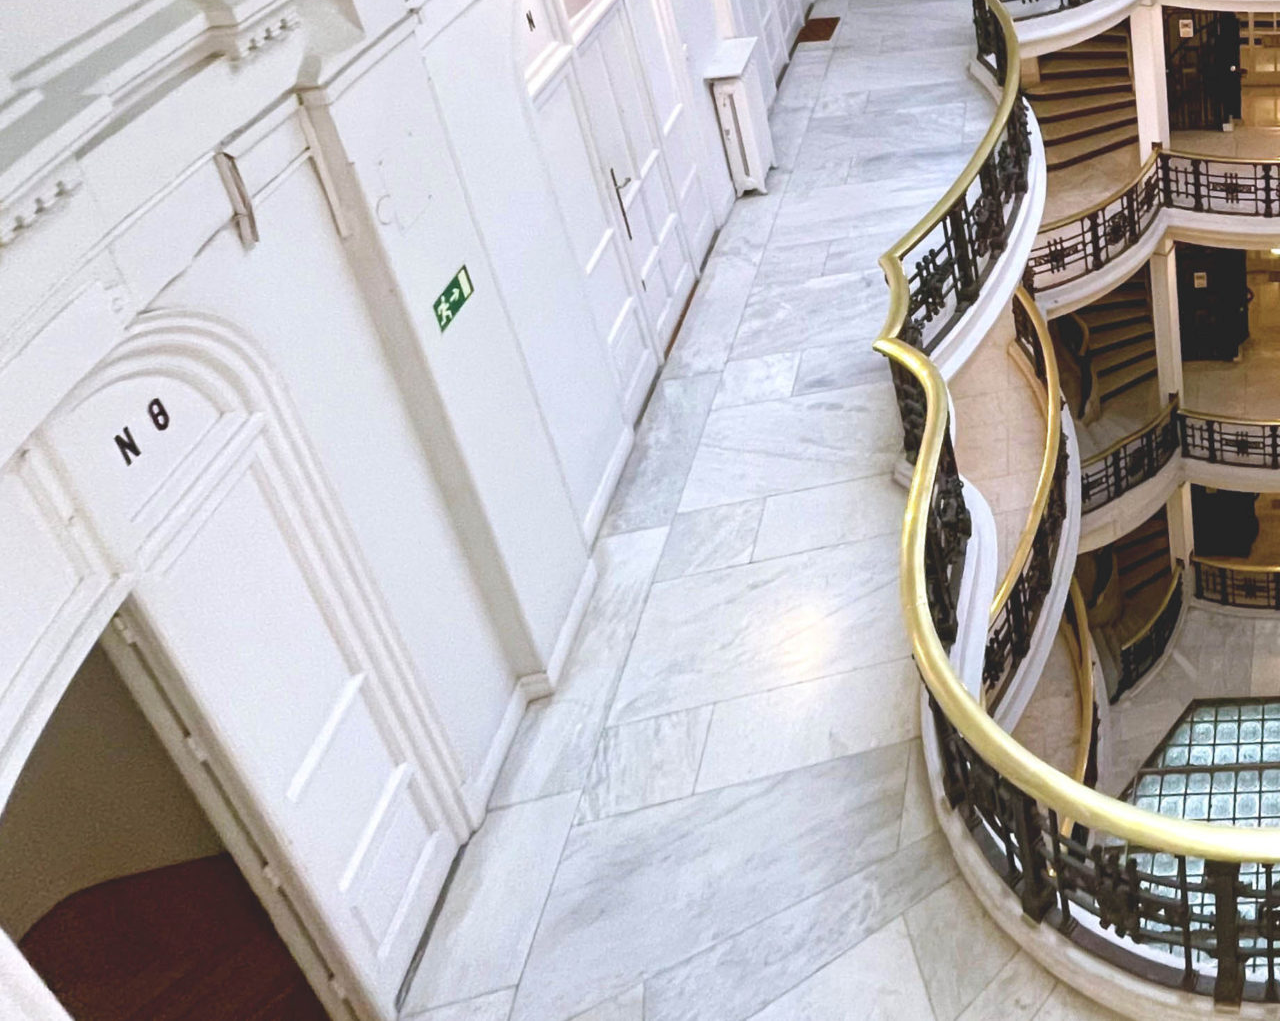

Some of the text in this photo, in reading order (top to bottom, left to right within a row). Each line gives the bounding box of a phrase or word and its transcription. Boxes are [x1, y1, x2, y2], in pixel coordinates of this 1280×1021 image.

[526, 9, 536, 32] N
[114, 397, 170, 466] N 8
